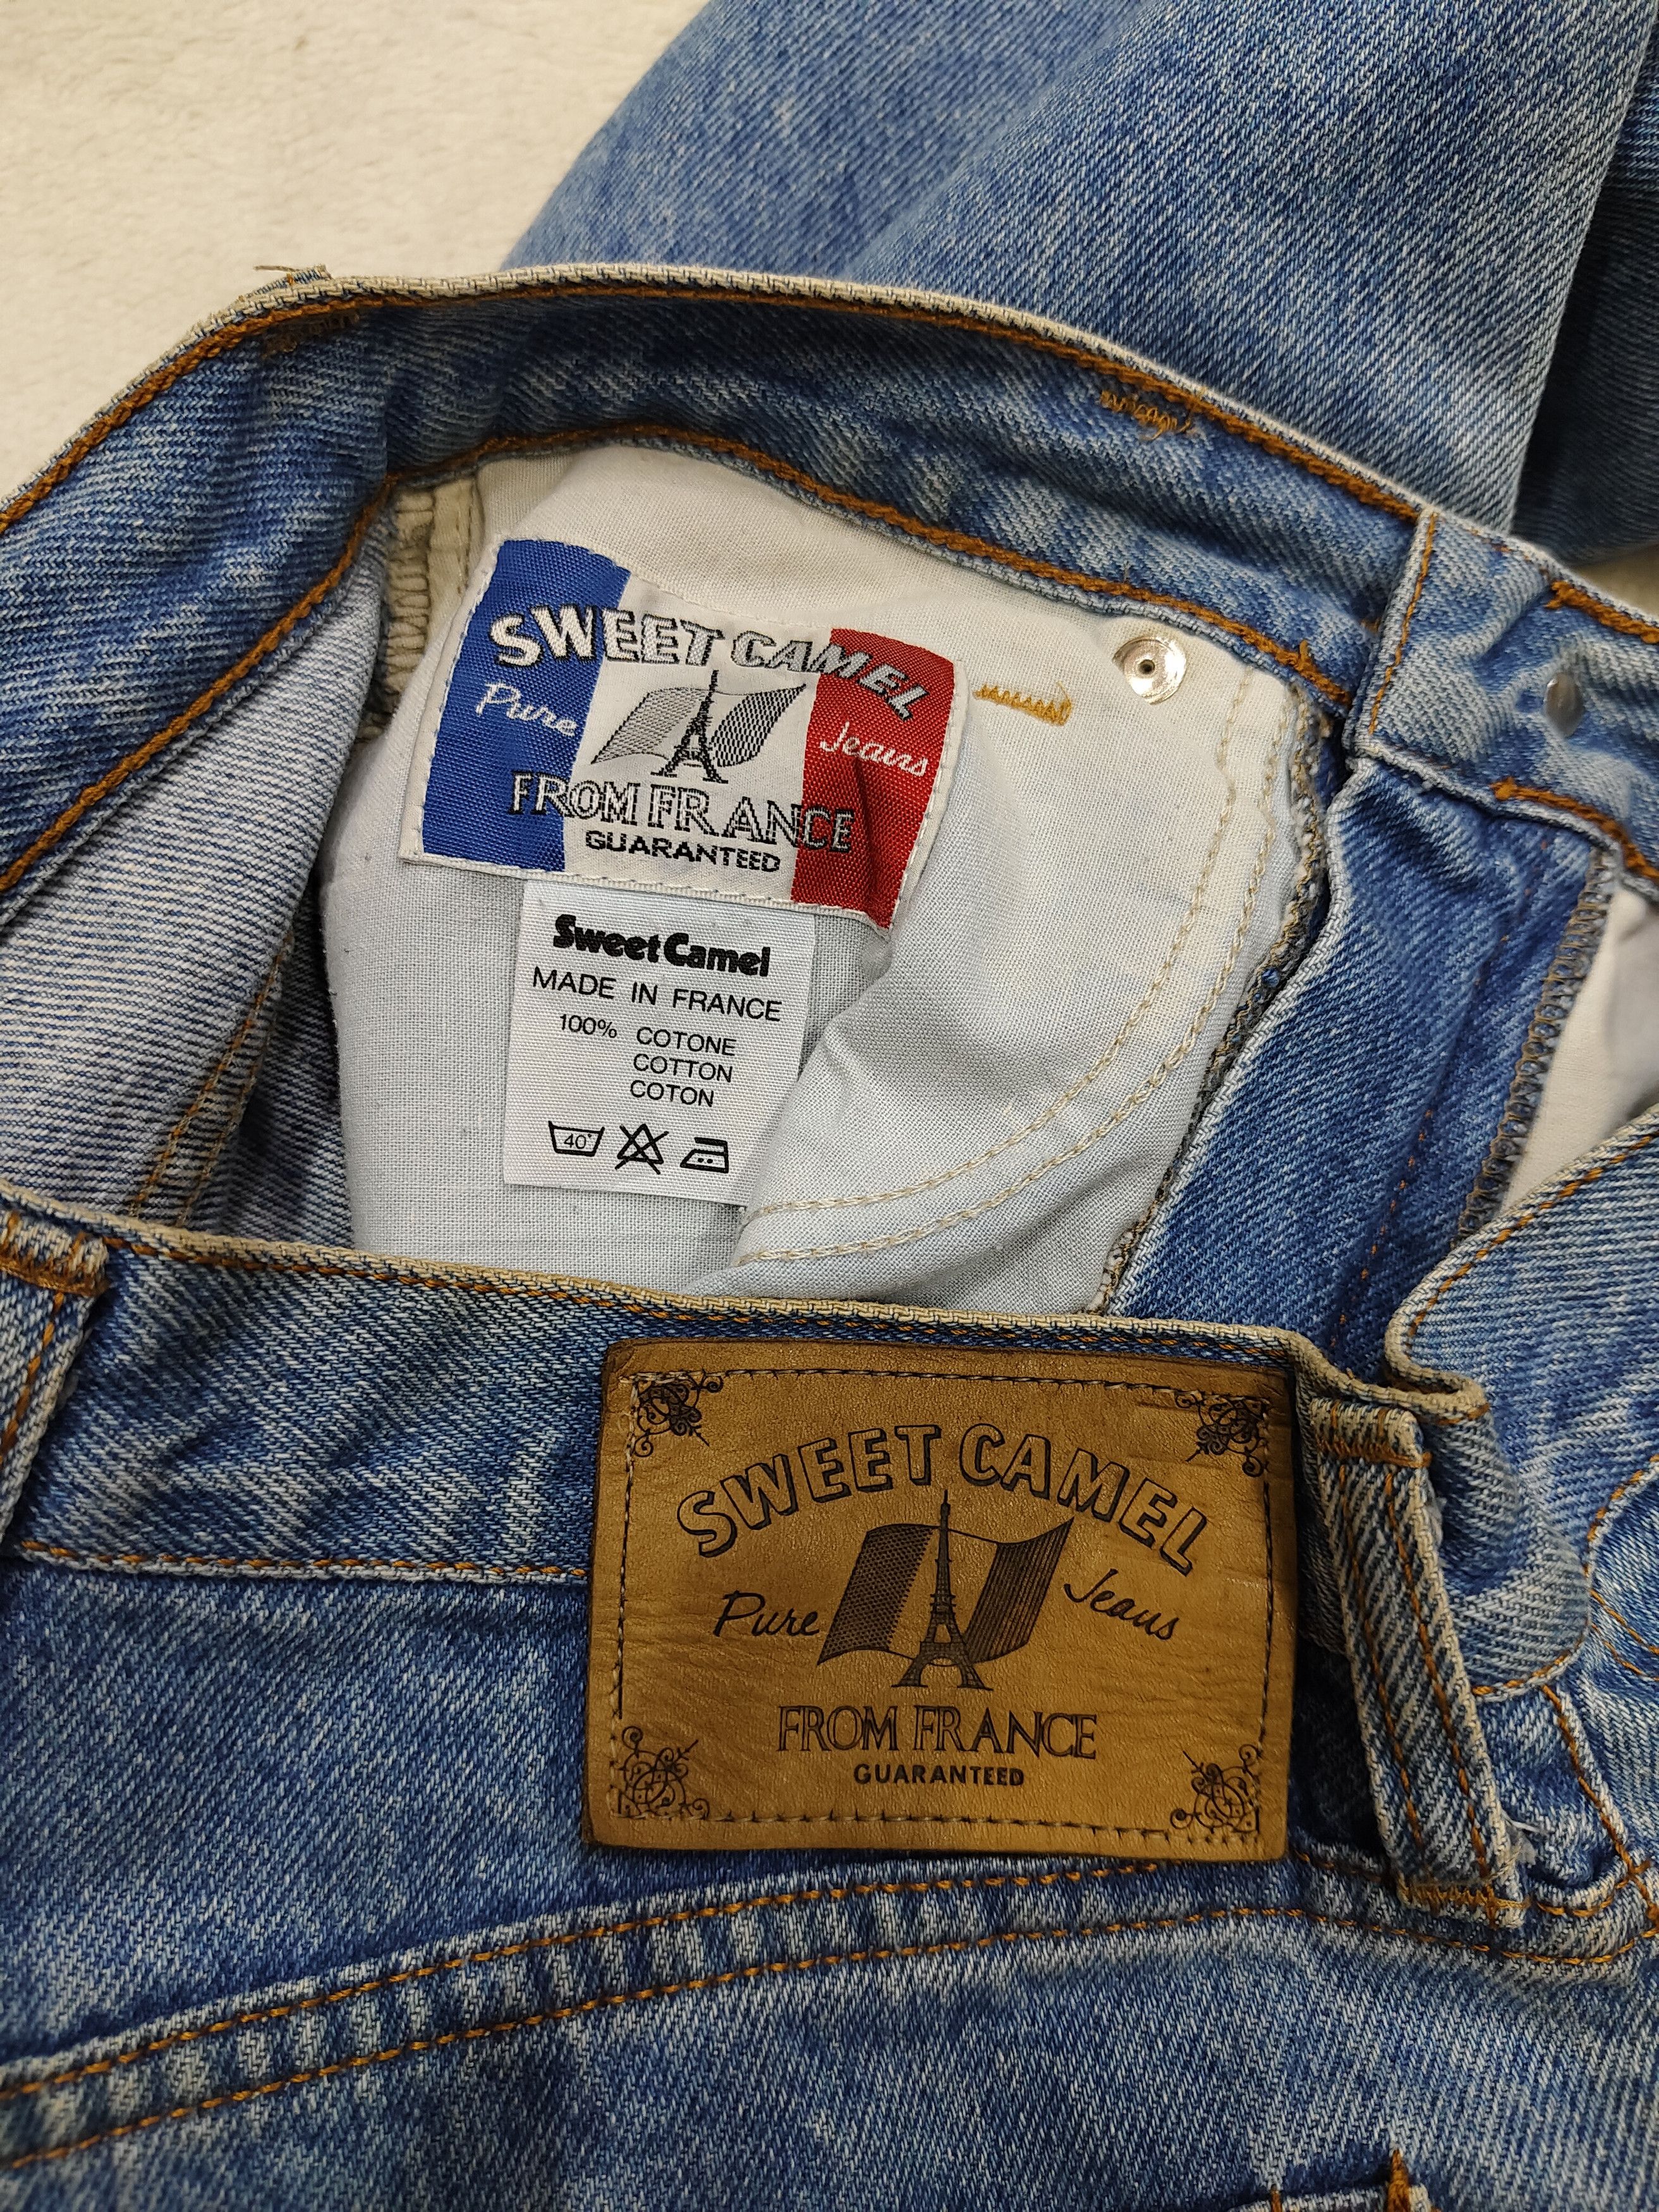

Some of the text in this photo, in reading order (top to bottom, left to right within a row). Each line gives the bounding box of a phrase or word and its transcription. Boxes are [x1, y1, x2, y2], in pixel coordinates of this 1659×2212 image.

[489, 604, 932, 722] SWEET CAMEL
[475, 681, 578, 737] Pure
[818, 722, 930, 777] Jeans
[508, 772, 855, 853] FROM FRANCE
[585, 830, 779, 873] GUARANTEED
[533, 967, 782, 1022] MADE IN FRANCE
[560, 1014, 736, 1056] 100% COTONE
[630, 1080, 715, 1108] COTON
[633, 1054, 733, 1083] COTTON
[676, 1423, 1208, 1576] SWEET CAMEL
[712, 1591, 822, 1639] Pure
[1063, 1569, 1179, 1641] Jeans
[777, 1704, 1097, 1759] FROM FRANCE
[854, 1764, 1025, 1787] GUARANTEED
